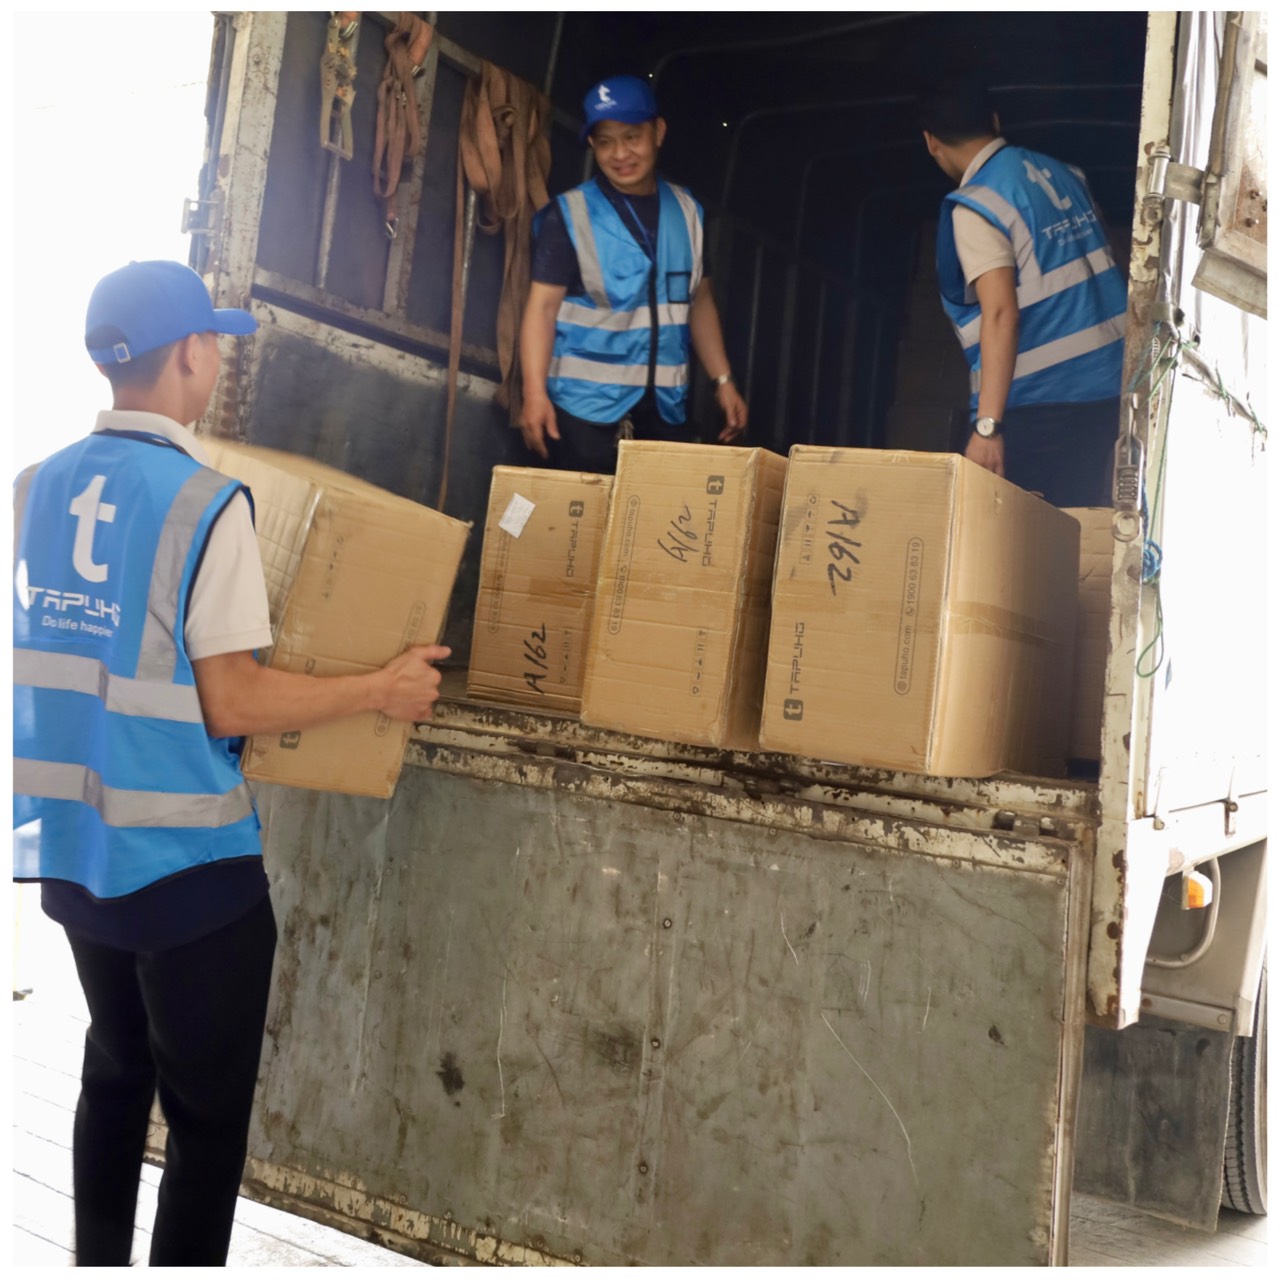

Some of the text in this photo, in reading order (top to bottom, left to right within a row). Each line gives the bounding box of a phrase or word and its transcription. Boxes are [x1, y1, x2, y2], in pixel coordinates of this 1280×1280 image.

[69, 474, 116, 583] t
[566, 520, 579, 578] TAPUHO
[701, 499, 718, 567] TAPUHO
[905, 541, 921, 605] 1900 63 83 19
[42, 615, 113, 638] Do life happier
[789, 622, 805, 695] TAPUHO
[898, 624, 912, 680] tapuho.com
